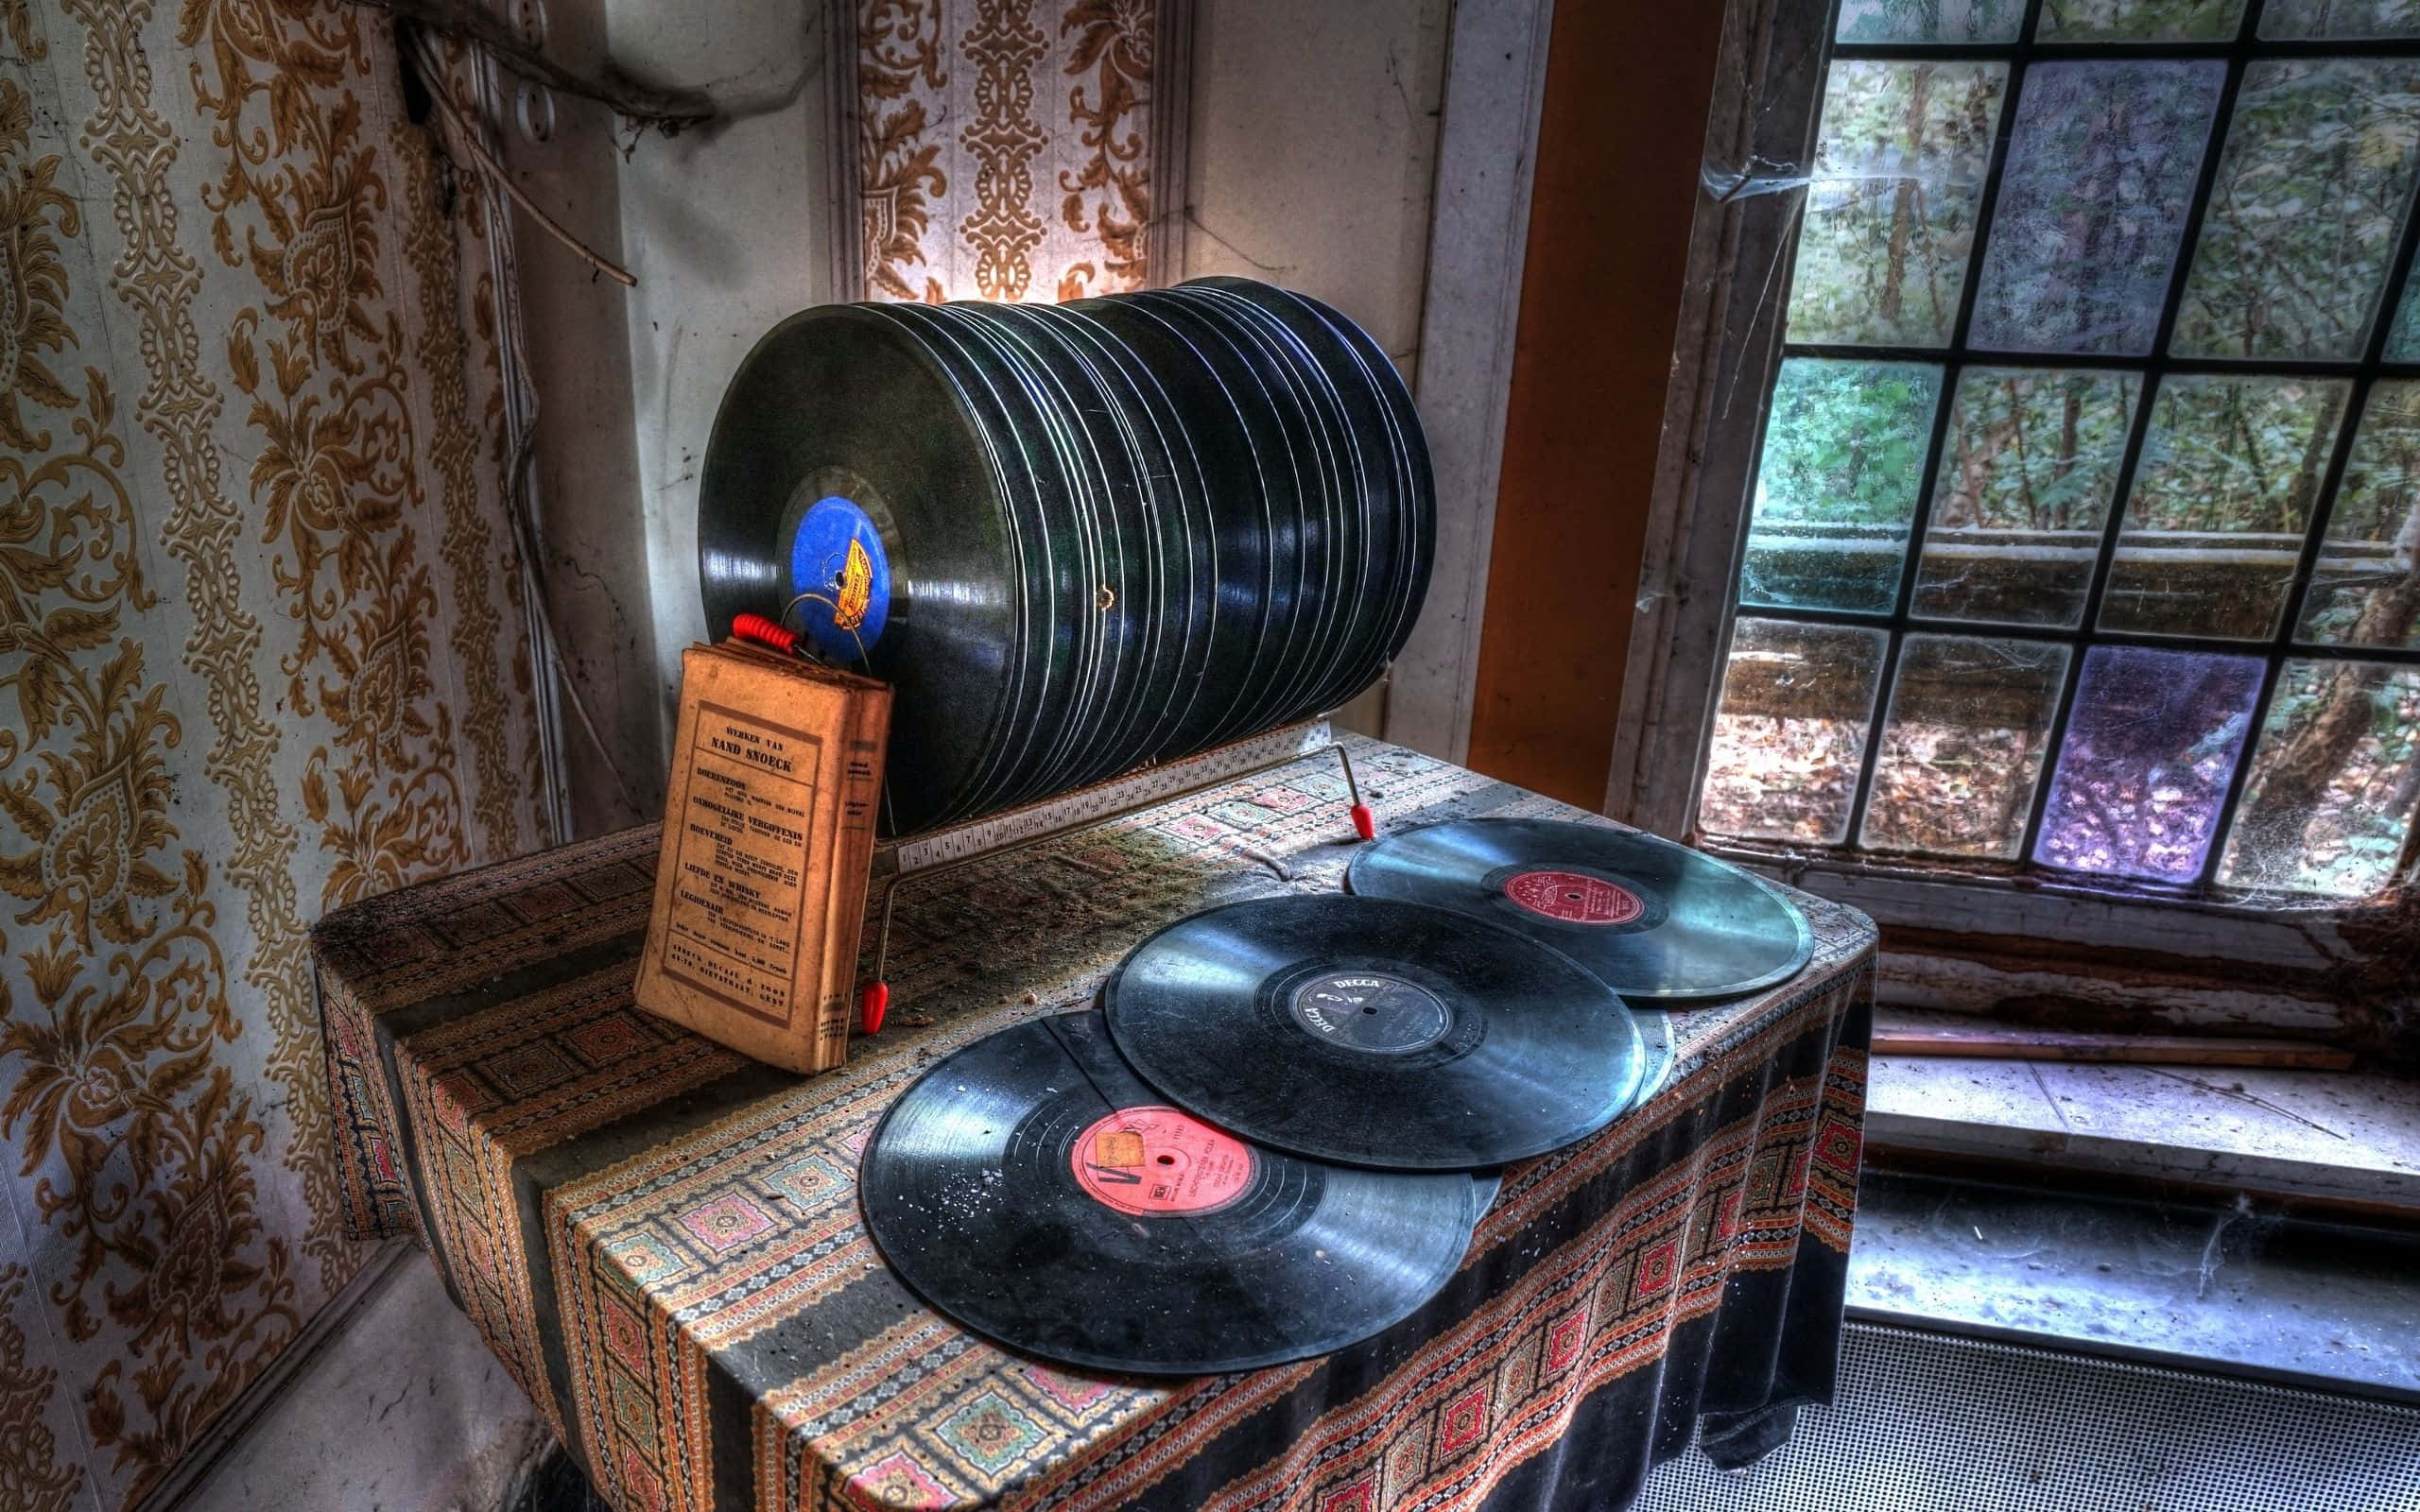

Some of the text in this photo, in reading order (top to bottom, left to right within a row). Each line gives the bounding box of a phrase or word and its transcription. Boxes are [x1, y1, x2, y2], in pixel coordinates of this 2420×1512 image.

[726, 726, 783, 751] WERKEN VAN
[711, 737, 792, 772] NAND SNOECK
[903, 853, 907, 862] 1
[923, 848, 928, 856] 3
[944, 841, 950, 850] 5
[957, 844, 961, 852] 6
[966, 835, 971, 844] 7
[977, 838, 982, 847] 8
[987, 830, 993, 838] 9
[996, 833, 1005, 841] 10
[1005, 824, 1011, 833] 11
[1035, 820, 1044, 829] 14
[684, 862, 710, 879] LIEFDE
[714, 874, 724, 884] EN
[728, 879, 761, 899] WHISKY
[680, 889, 724, 915] LEGIOENAIR
[1333, 979, 1380, 988] DECCA
[1305, 1007, 1336, 1033] DECCA
